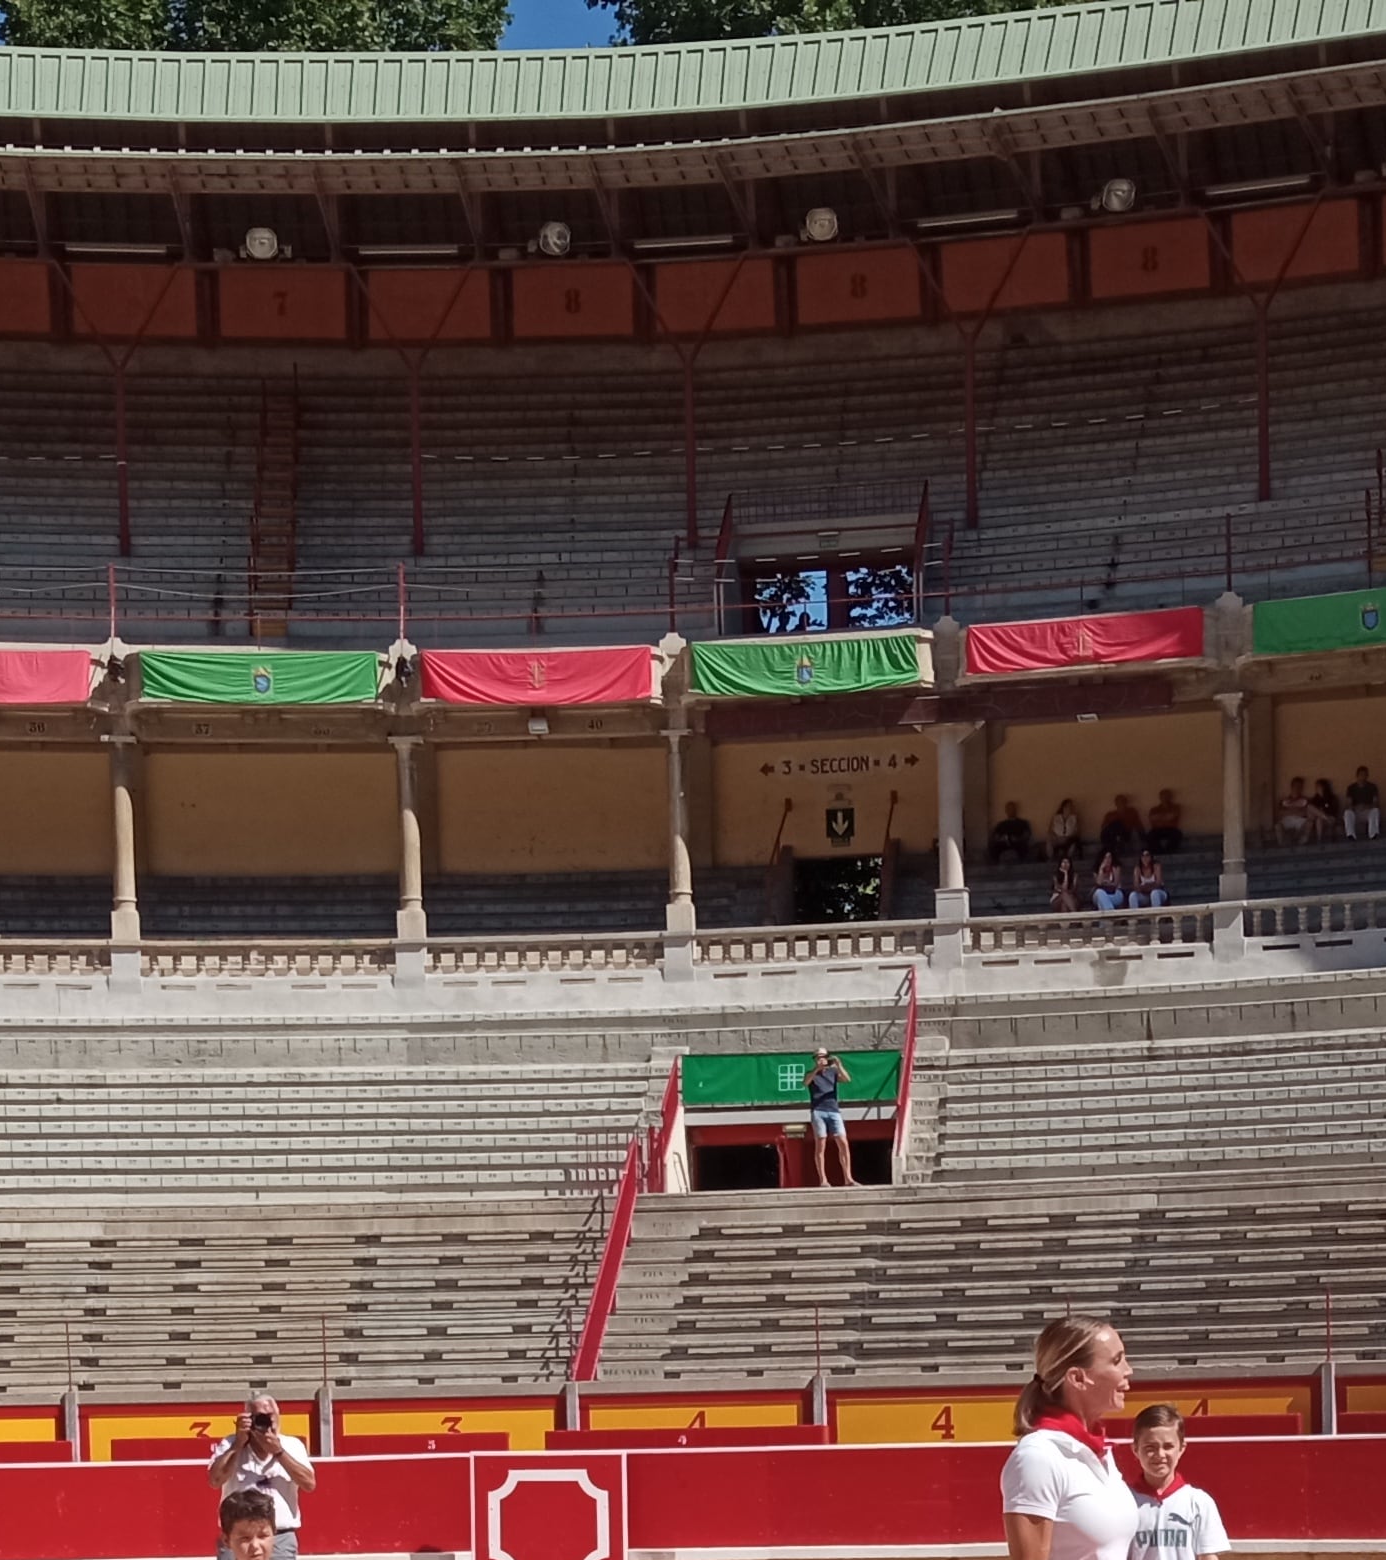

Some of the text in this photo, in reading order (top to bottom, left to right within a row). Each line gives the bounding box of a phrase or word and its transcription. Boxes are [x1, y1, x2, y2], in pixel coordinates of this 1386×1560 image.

[1142, 245, 1160, 272] 8
[850, 272, 868, 299] 8
[272, 290, 289, 317] 7
[564, 287, 582, 314] 8
[781, 753, 898, 775] 3 SECCION 4
[931, 1405, 955, 1440] 4
[1135, 1529, 1188, 1549] PUMA
